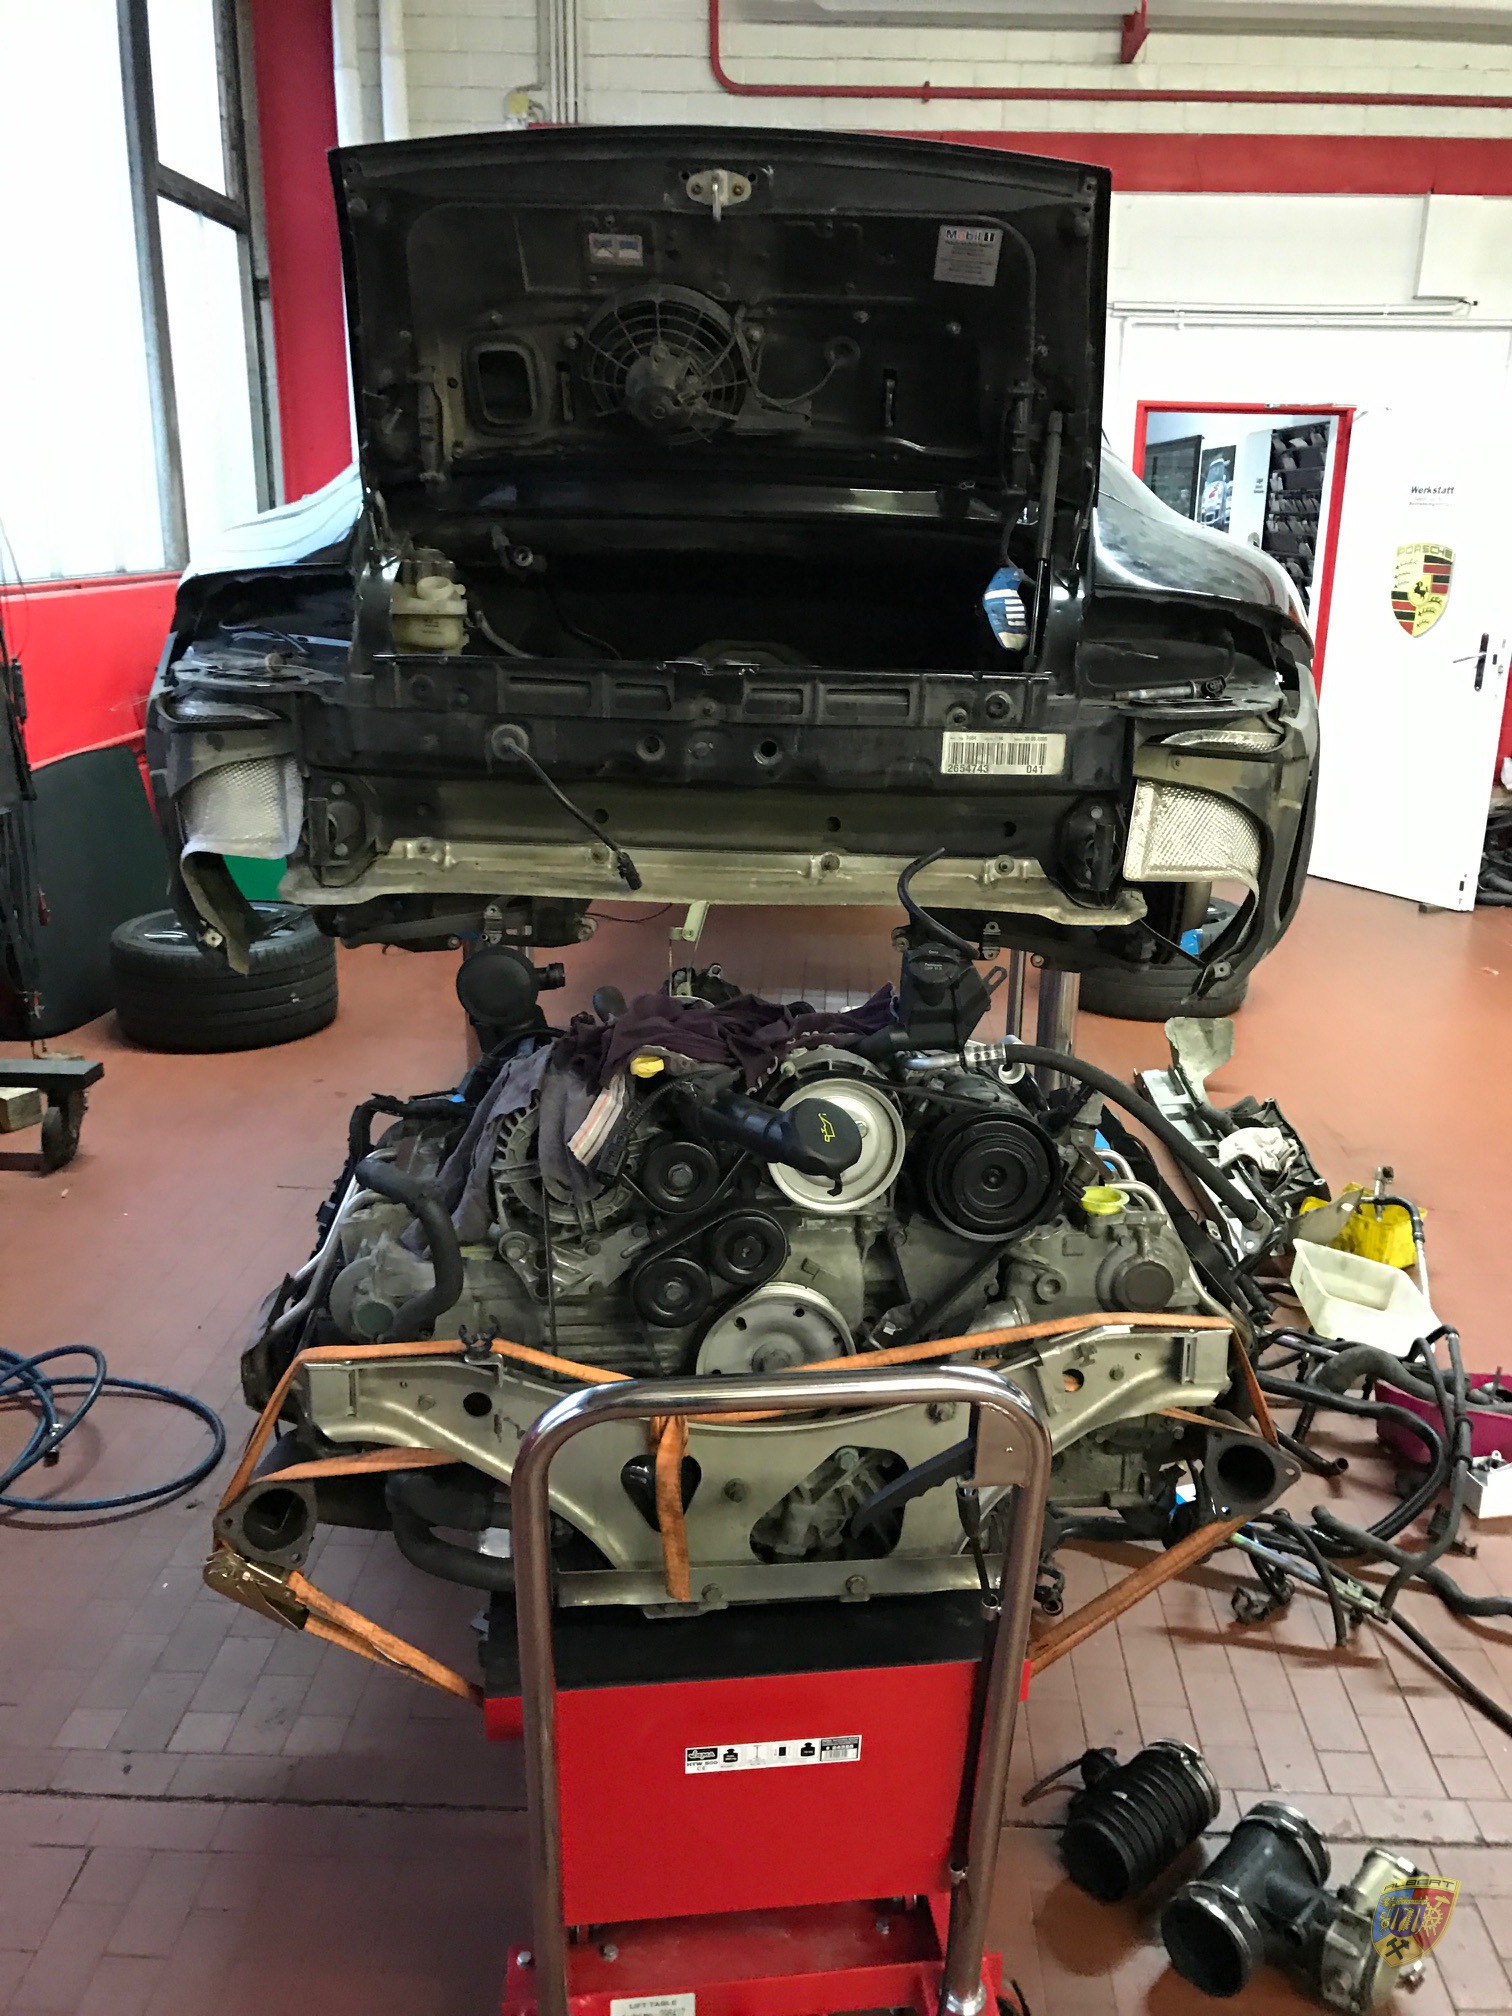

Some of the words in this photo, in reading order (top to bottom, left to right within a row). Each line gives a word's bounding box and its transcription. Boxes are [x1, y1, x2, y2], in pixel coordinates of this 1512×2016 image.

[946, 229, 982, 241] Mobil
[1411, 485, 1455, 494] Werkstatt
[1397, 545, 1453, 560] PORSCHE
[947, 764, 989, 773] 2654743
[1026, 765, 1043, 774] 041
[650, 2000, 677, 2008] TABLE
